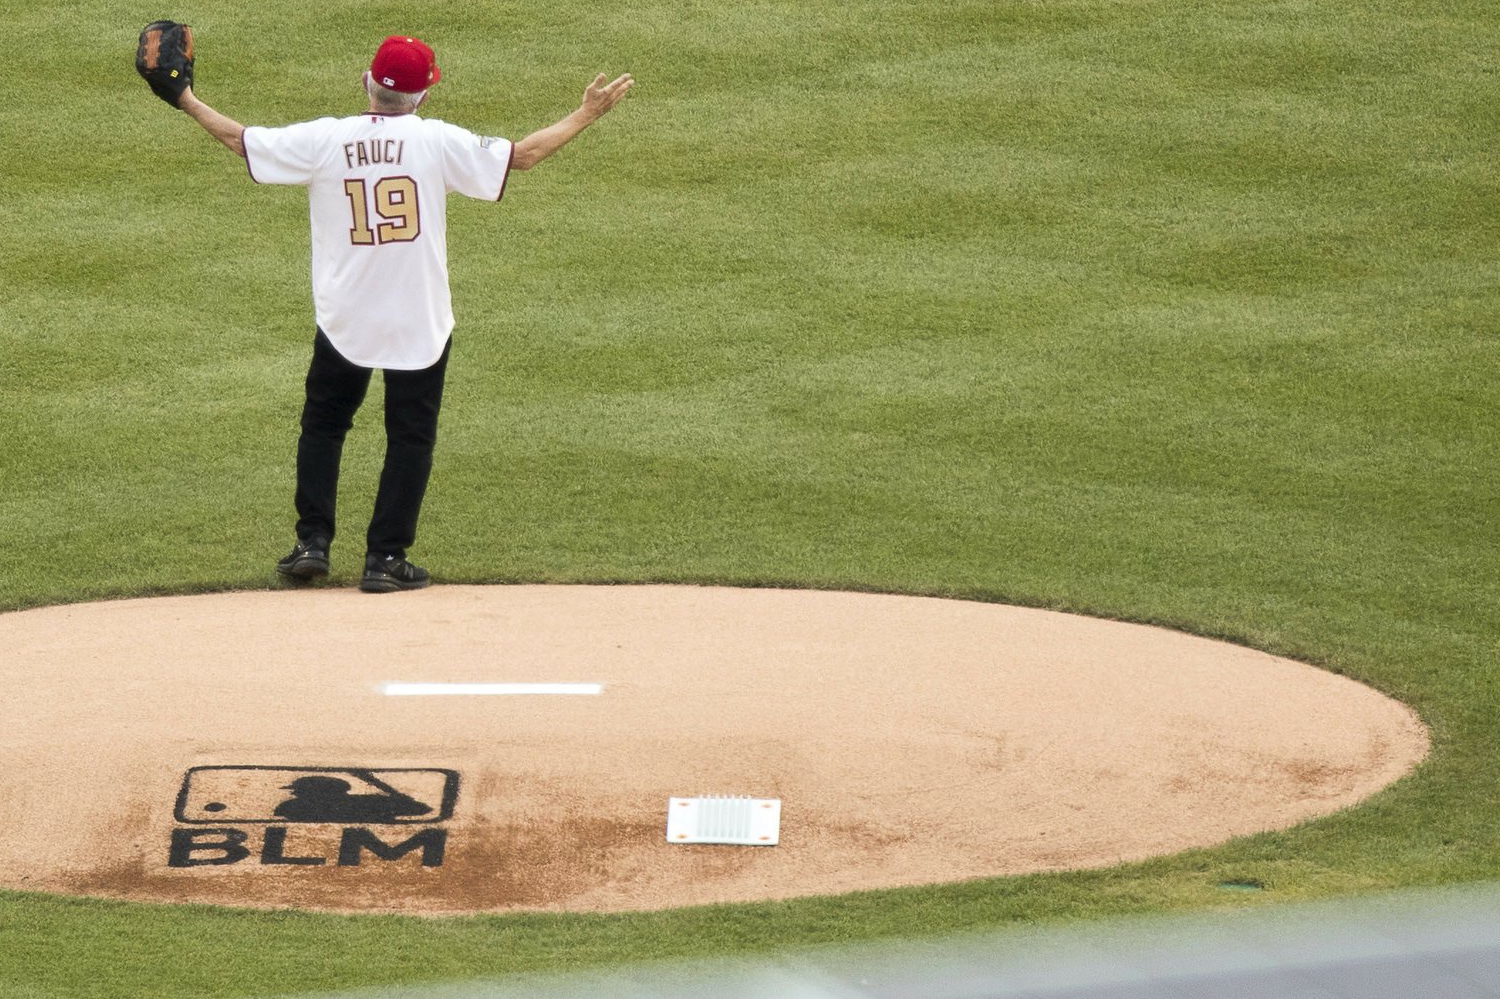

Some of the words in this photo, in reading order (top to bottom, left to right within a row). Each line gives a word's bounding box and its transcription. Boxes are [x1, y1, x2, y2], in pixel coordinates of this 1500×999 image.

[343, 139, 405, 168] FAUCI
[344, 175, 422, 245] 19
[168, 827, 448, 867] BLM
